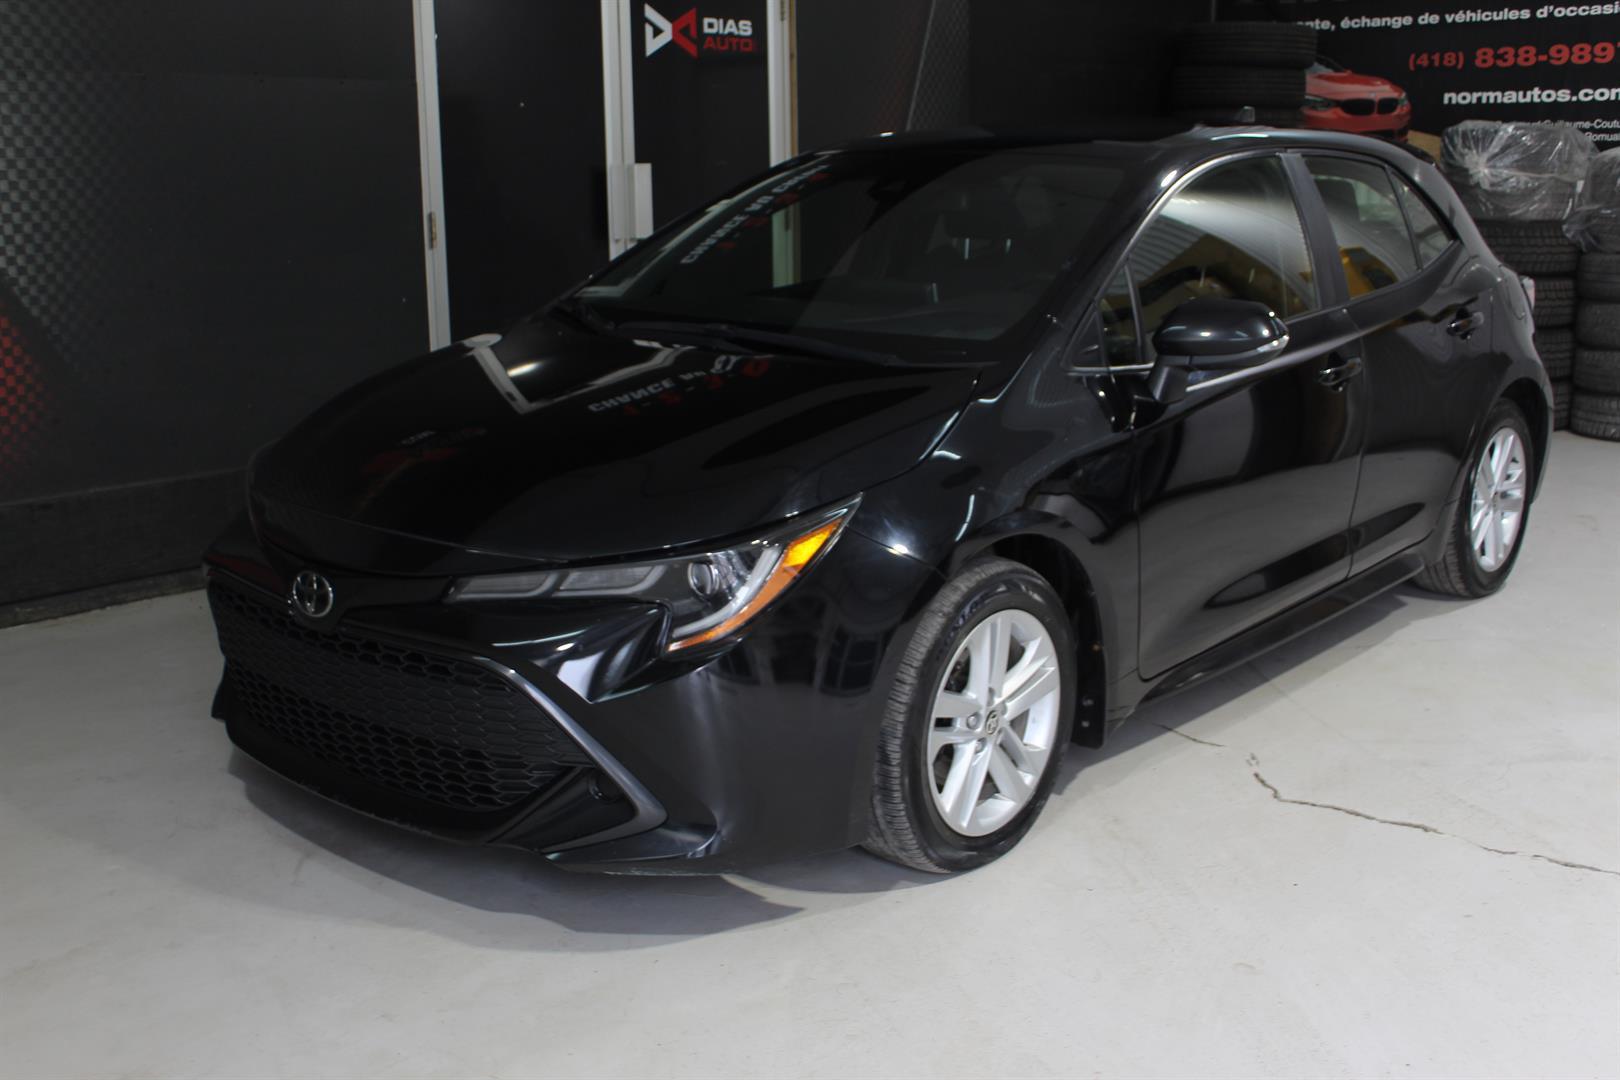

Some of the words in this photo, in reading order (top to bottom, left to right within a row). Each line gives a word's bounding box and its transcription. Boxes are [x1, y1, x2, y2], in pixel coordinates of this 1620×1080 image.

[703, 16, 753, 37] DIAS
[1340, 14, 1413, 30] échange
[1417, 12, 1440, 25] de
[1445, 7, 1531, 23] véhicules
[1535, 1, 1620, 18] d'occasi
[703, 36, 754, 53] AUTO
[1408, 50, 1465, 71] (418)
[1474, 41, 1620, 68] 838-989
